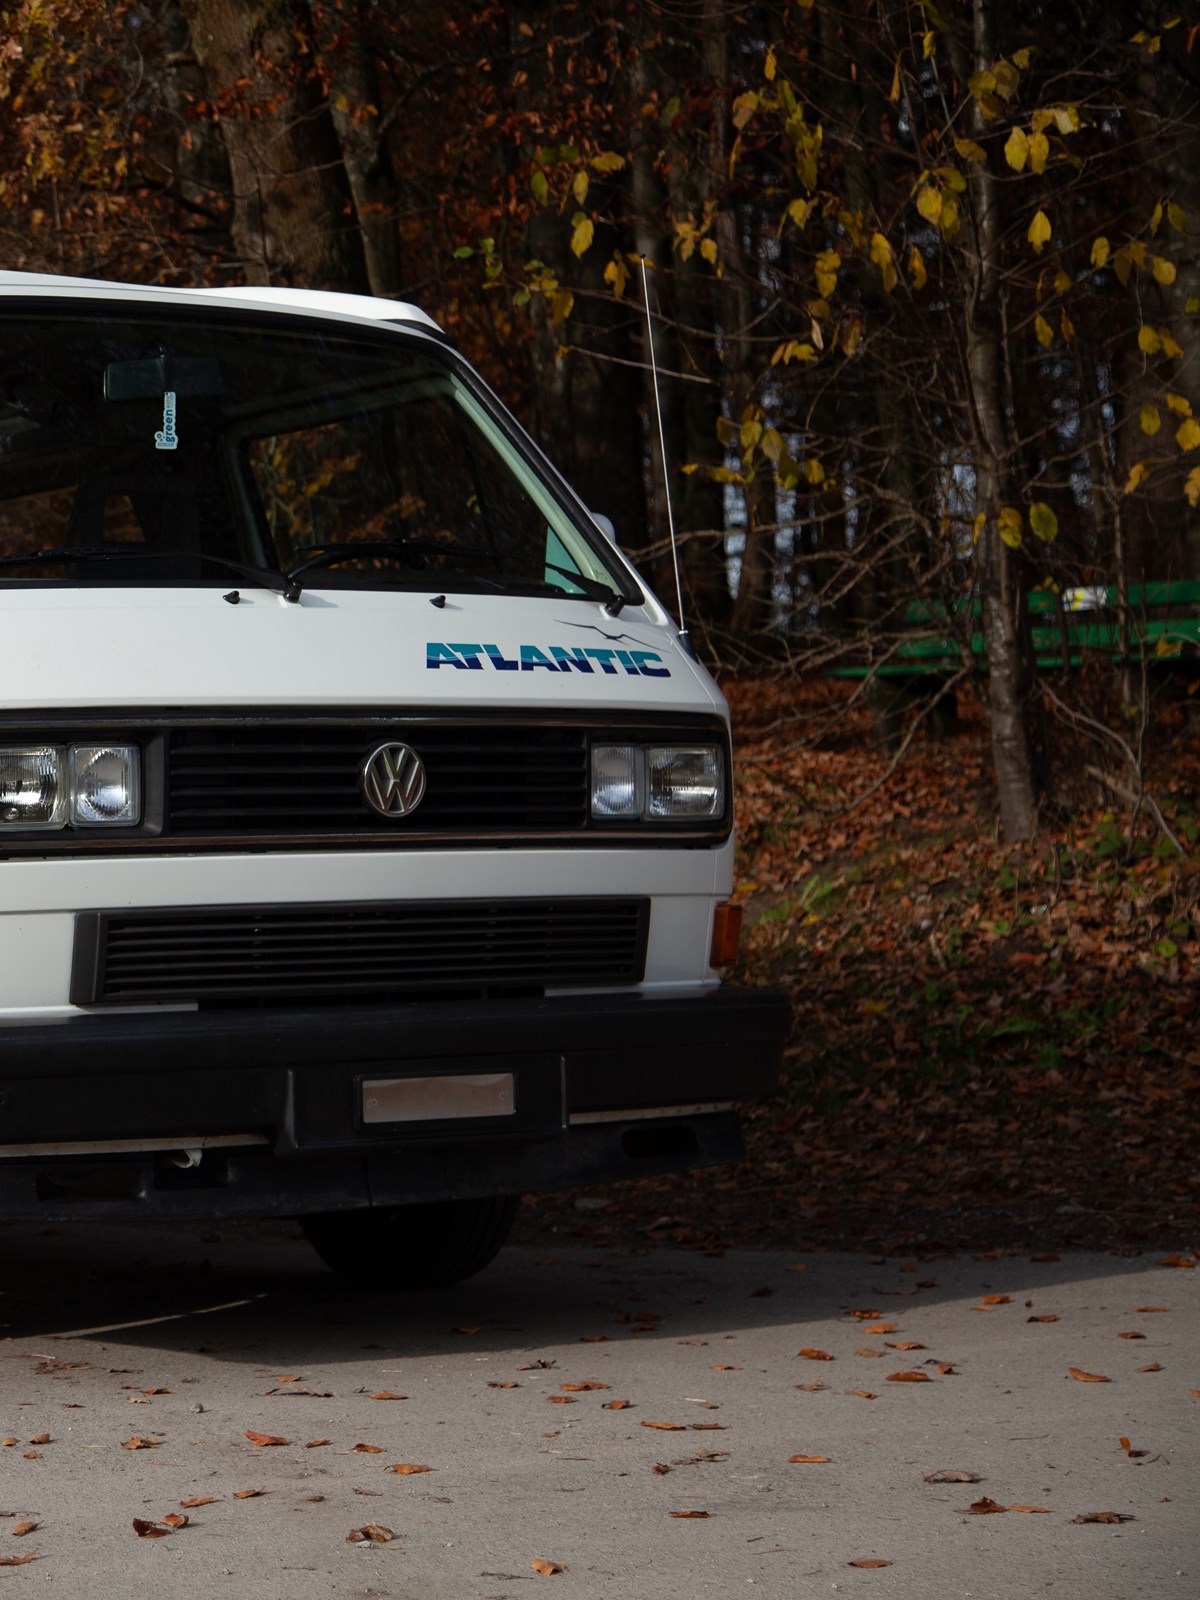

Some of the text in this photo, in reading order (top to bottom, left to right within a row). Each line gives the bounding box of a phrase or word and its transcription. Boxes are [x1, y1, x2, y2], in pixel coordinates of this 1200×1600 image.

[165, 409, 176, 443] green
[426, 642, 671, 678] ATLANTIC
[365, 743, 425, 816] VW
